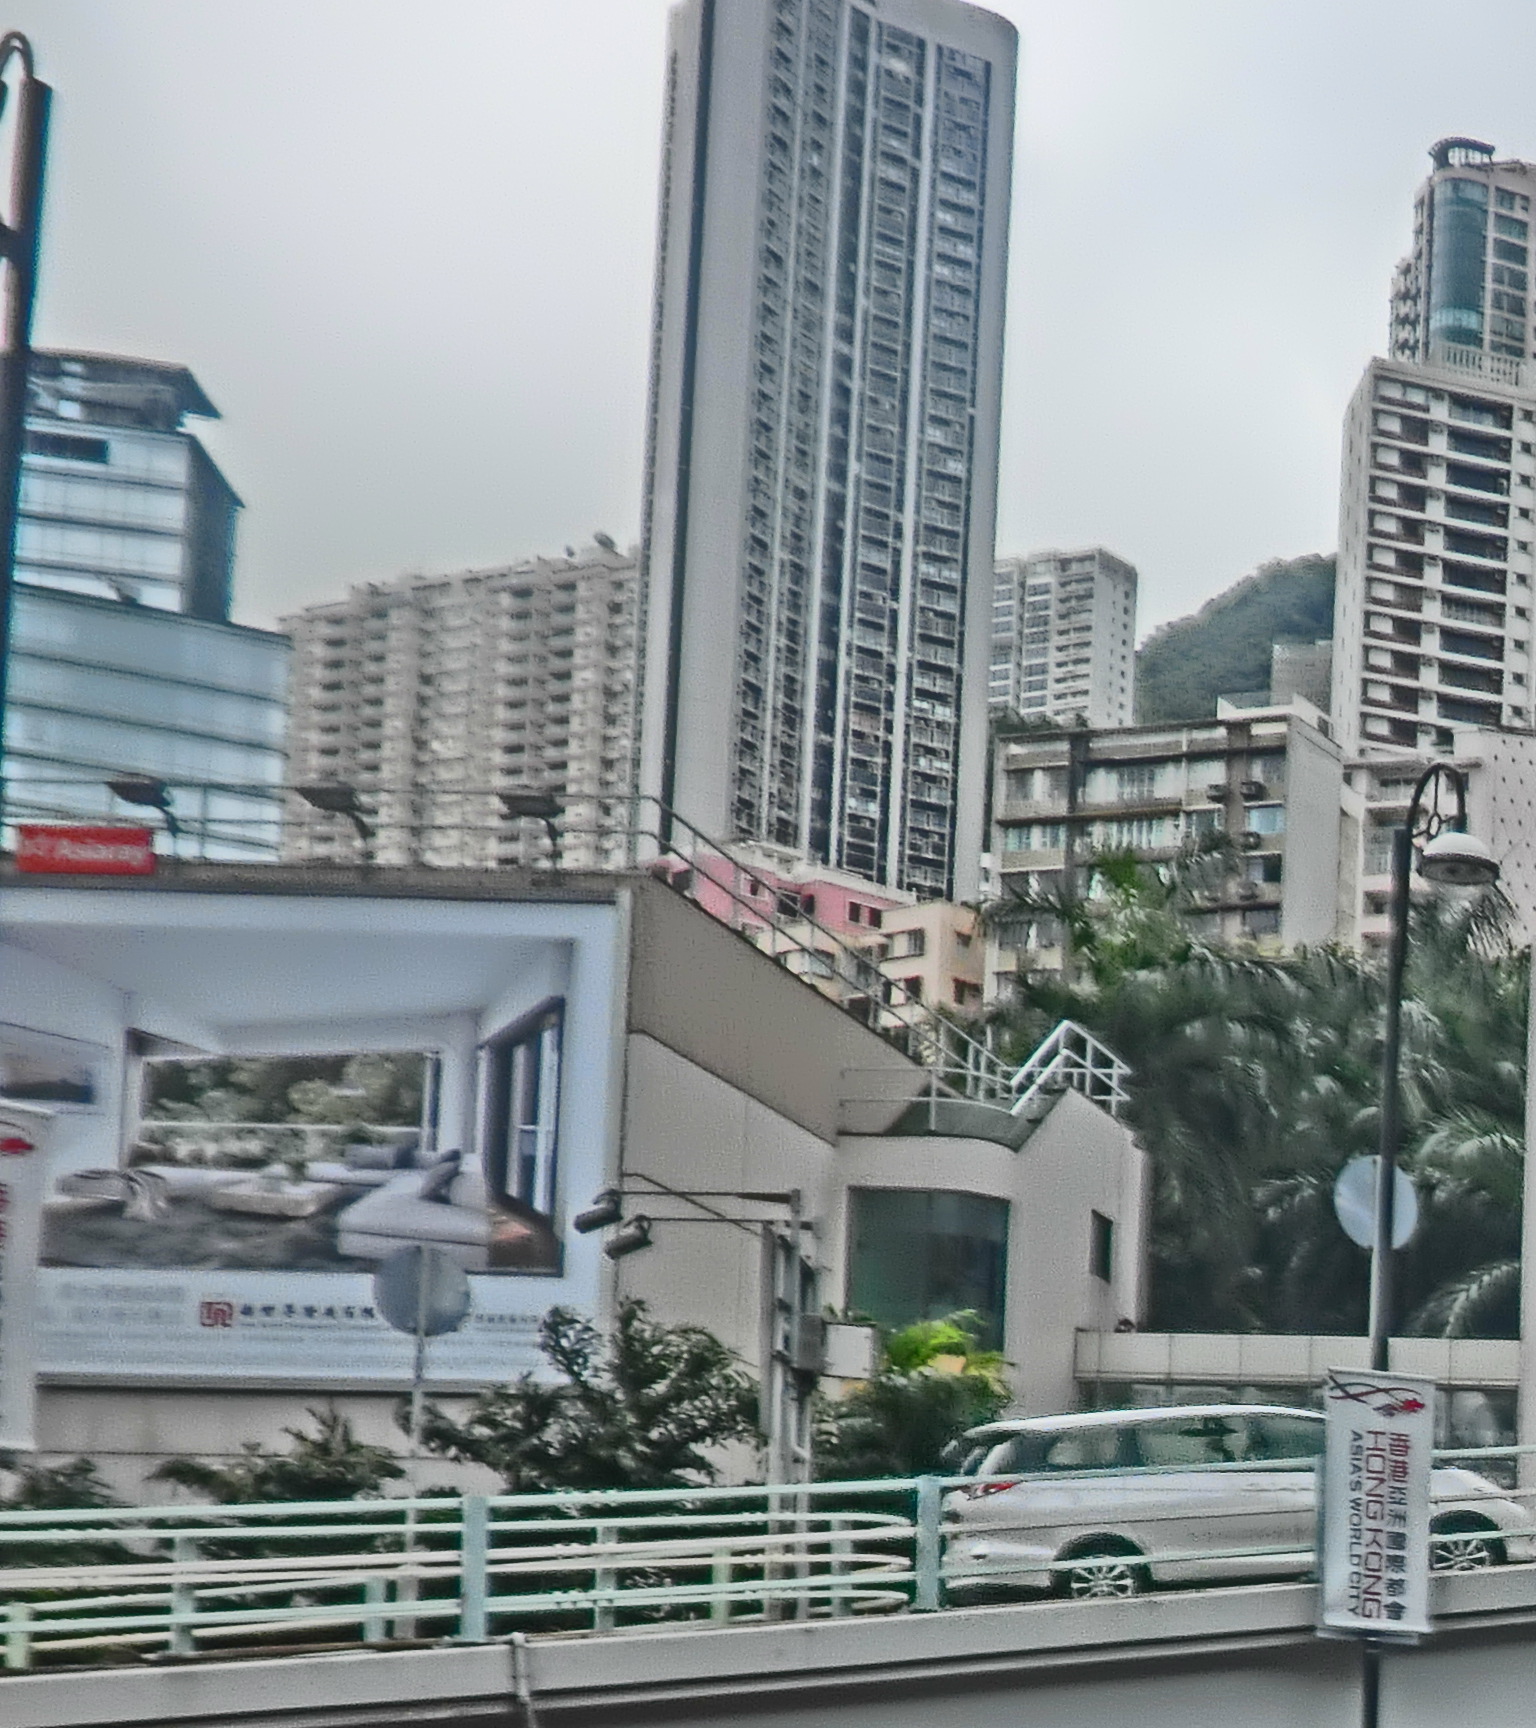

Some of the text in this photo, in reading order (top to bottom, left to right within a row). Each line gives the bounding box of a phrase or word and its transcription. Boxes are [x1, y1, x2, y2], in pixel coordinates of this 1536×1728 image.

[1347, 1430, 1363, 1617] ASIA'S WORLD CITY
[1362, 1430, 1387, 1619] HONG KONG
